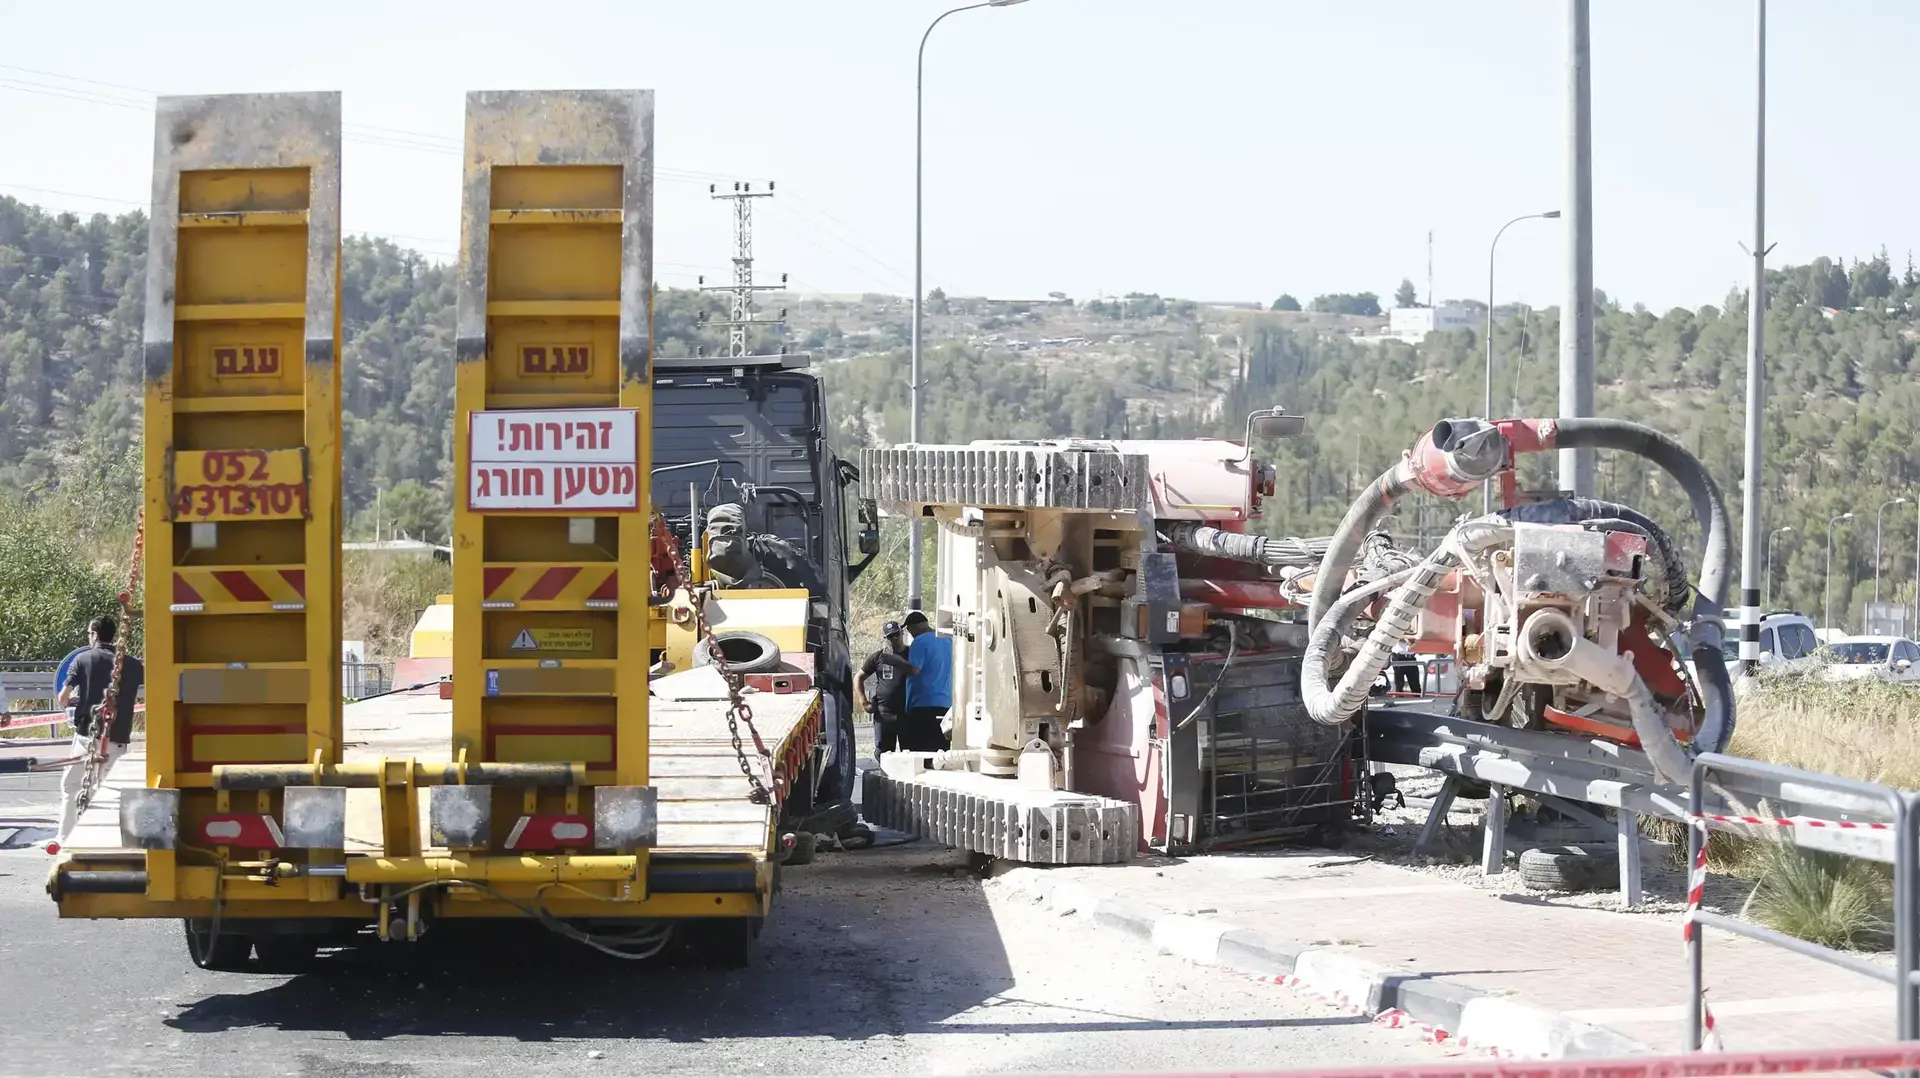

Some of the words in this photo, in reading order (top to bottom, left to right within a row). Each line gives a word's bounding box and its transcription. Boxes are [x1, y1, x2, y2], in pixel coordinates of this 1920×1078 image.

[497, 418, 613, 452] זהירות!
[203, 450, 270, 482] 052
[477, 467, 544, 498] חורג
[553, 465, 634, 505] מטען
